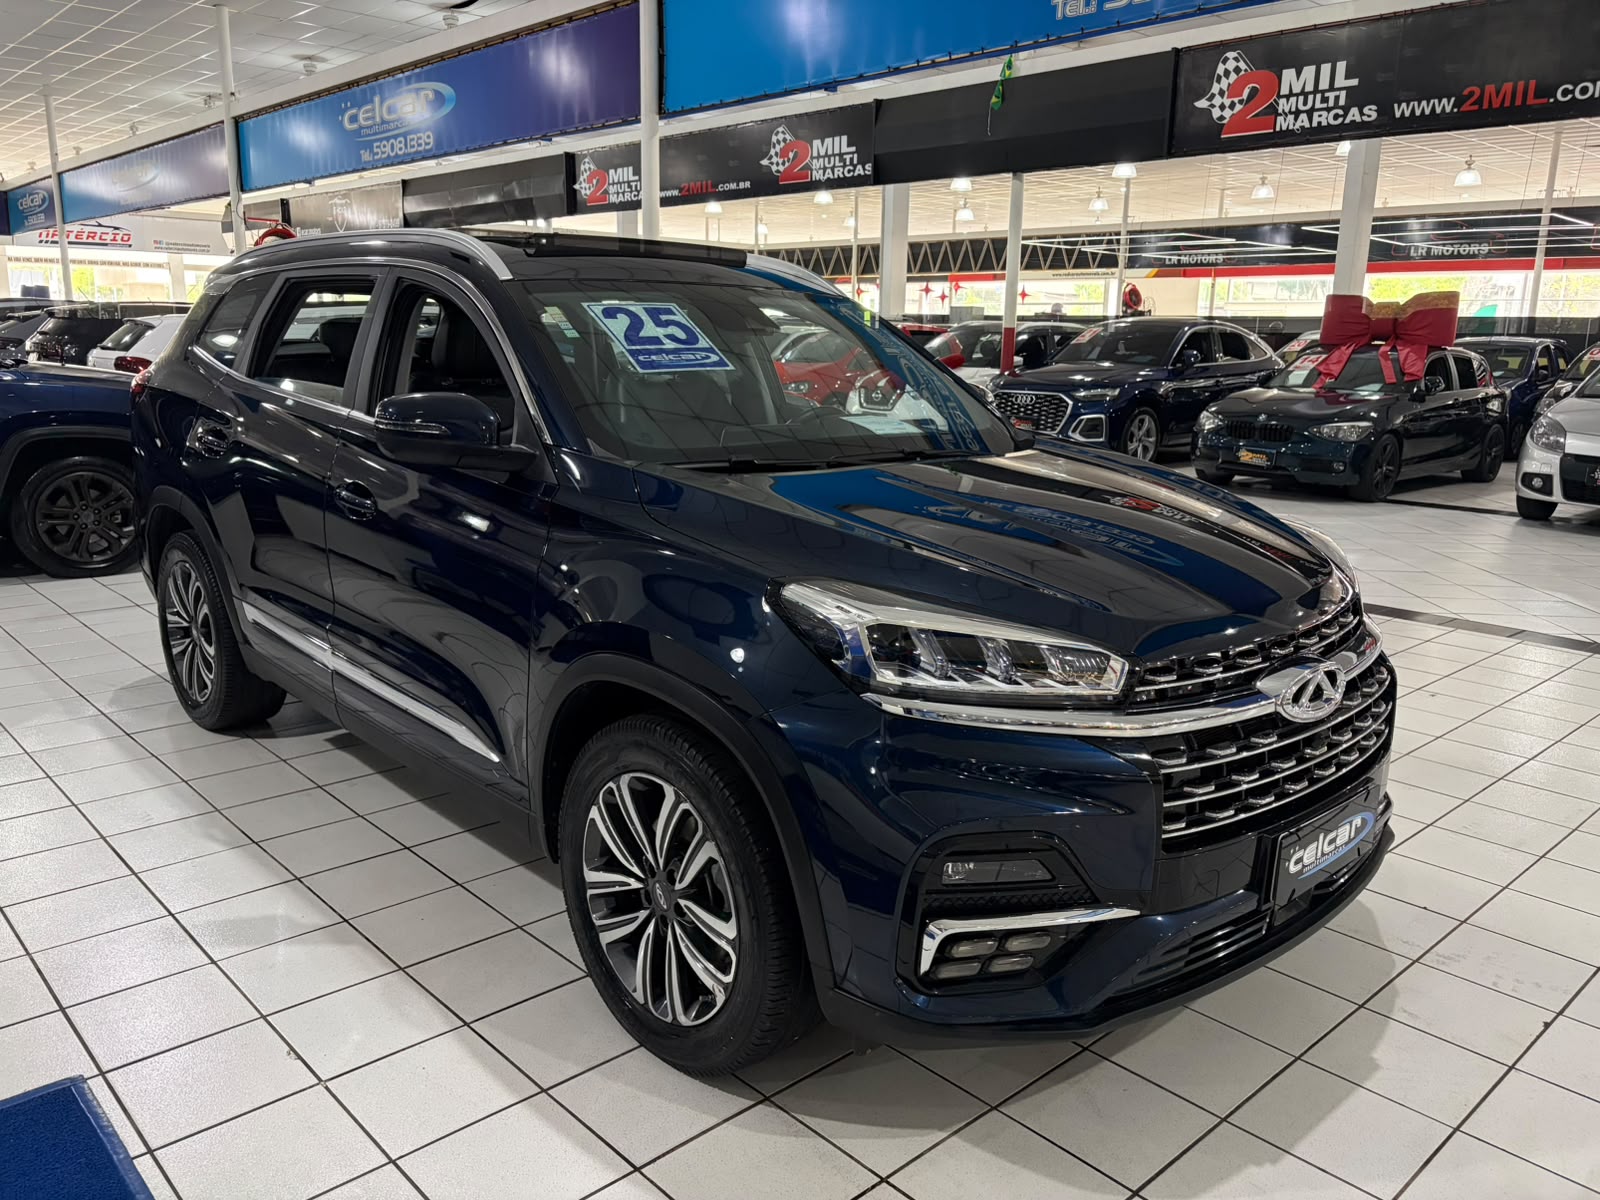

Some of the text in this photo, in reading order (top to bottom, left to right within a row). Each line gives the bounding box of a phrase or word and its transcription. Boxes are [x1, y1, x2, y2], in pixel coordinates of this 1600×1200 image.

[1221, 60, 1359, 138] 2 MIL
[1278, 90, 1347, 113] MULTI
[1276, 105, 1378, 132] MARCAS
[779, 135, 856, 184] 2 MIL
[812, 153, 858, 169] MULTI
[812, 163, 872, 182] MARCAS
[587, 166, 639, 206] 2 MIL
[609, 190, 642, 204] MARCA
[1409, 243, 1489, 257] LR MOTORS
[601, 306, 700, 347] 25
[1288, 815, 1362, 874] celcar
